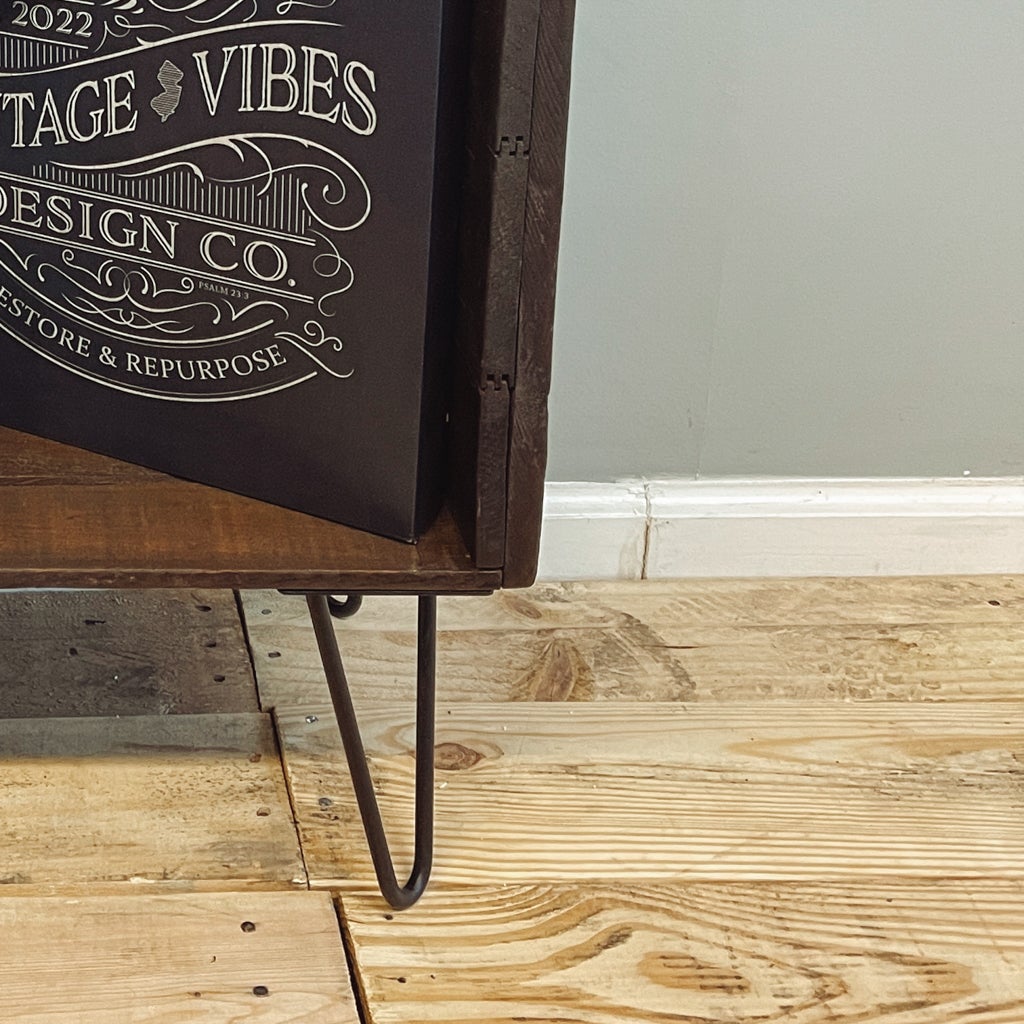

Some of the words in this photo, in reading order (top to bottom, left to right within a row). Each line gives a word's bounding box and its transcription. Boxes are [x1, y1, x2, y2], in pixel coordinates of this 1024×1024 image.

[11, 0, 94, 38] 2022
[192, 43, 377, 136] VIBES
[199, 231, 298, 288] CO.
[198, 280, 229, 296] PSALM
[98, 345, 118, 368] &
[126, 344, 288, 381] REPURPOSE
